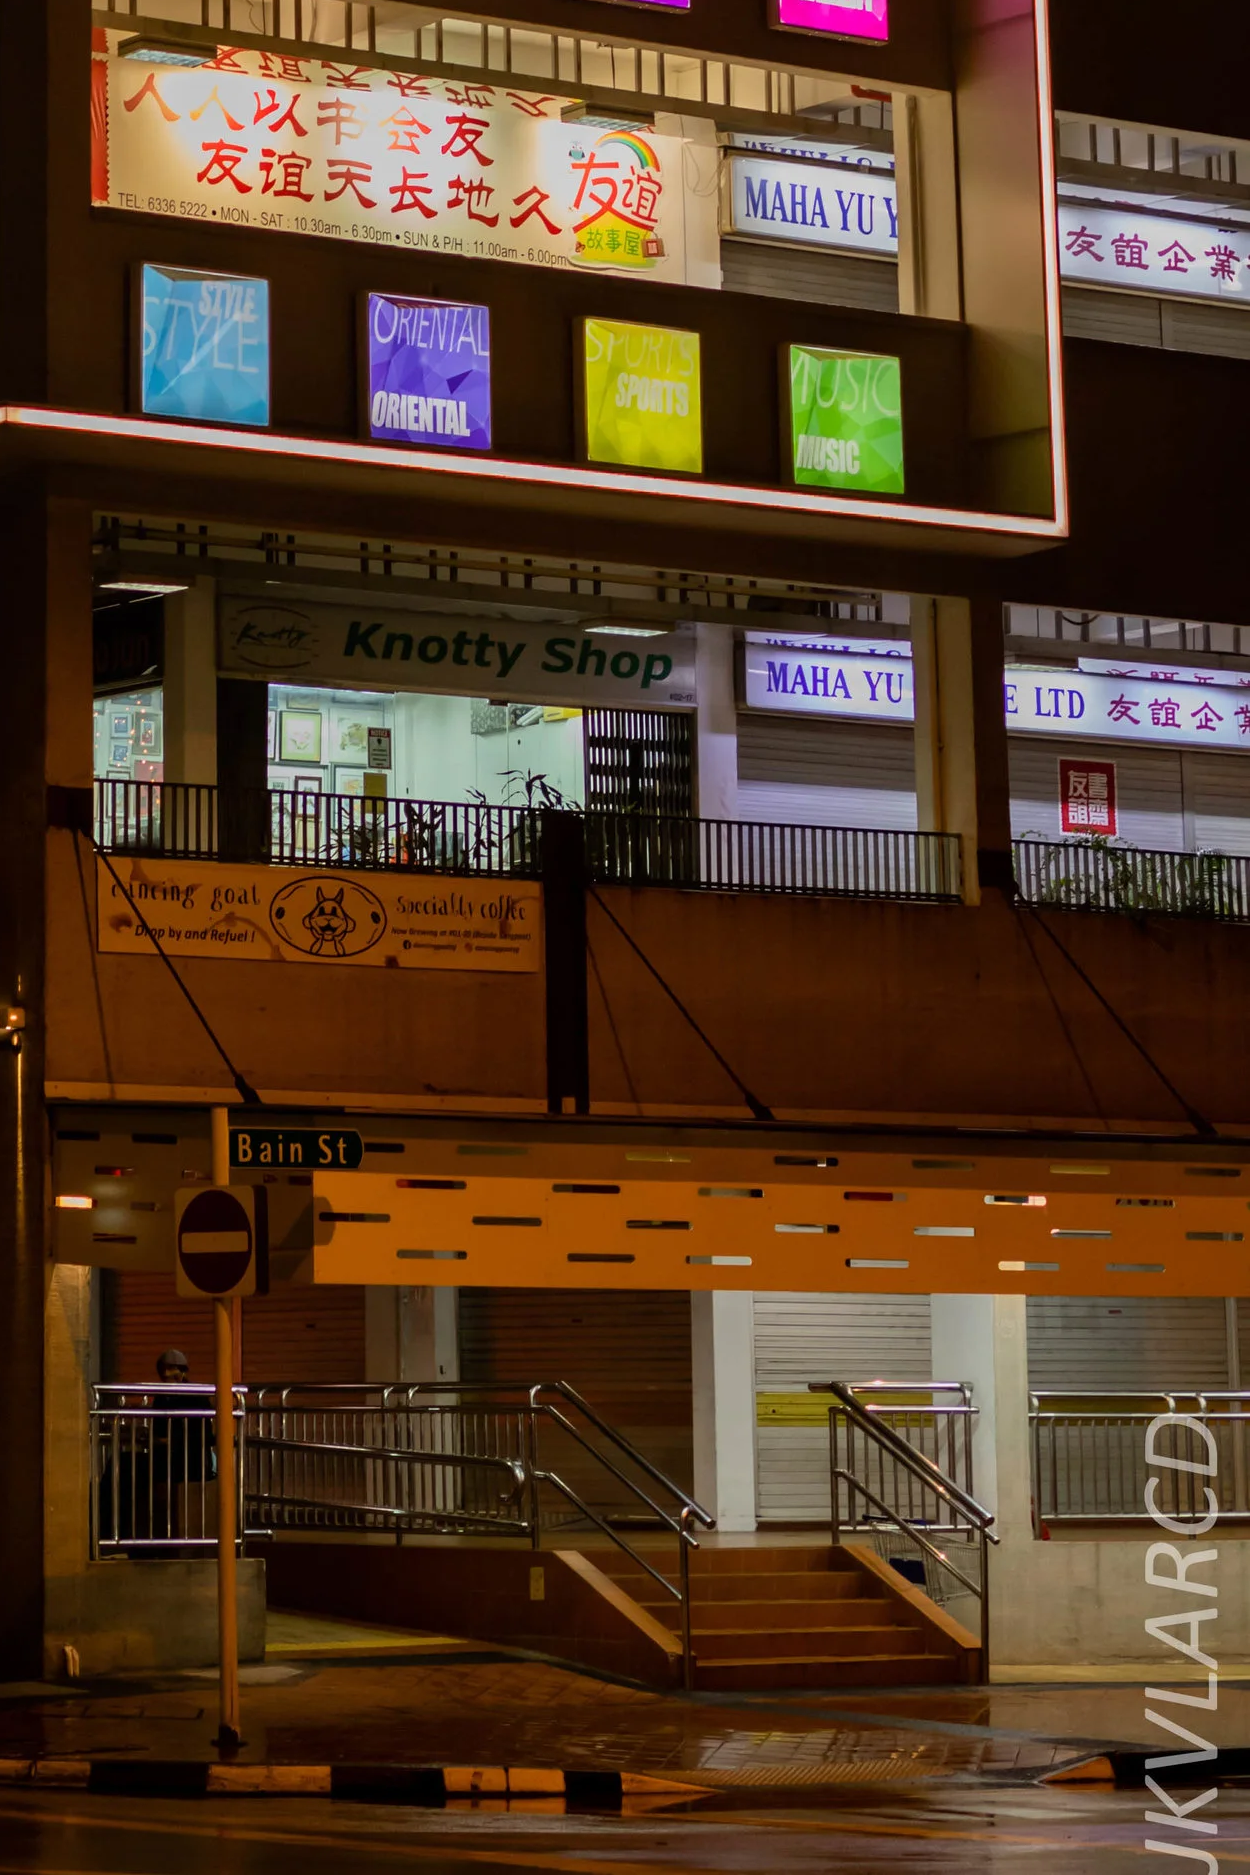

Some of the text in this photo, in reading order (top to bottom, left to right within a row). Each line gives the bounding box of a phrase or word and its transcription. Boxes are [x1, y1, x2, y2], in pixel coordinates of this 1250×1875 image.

[123, 71, 495, 168] 人人以书会友
[197, 138, 563, 236] 友谊天长地久
[571, 152, 662, 234] 友谊
[745, 176, 829, 229] MAHA
[835, 189, 875, 236] YU
[118, 192, 145, 210] TEL:
[148, 196, 176, 214] 6336
[180, 200, 208, 218] 5222
[220, 206, 250, 224] MON
[260, 211, 284, 228] SAT
[294, 216, 342, 236] 10.30am
[352, 224, 392, 244] 6.30pm
[403, 230, 428, 248] SUN
[443, 236, 464, 252] P/H
[473, 240, 518, 260] 11.00am
[528, 247, 567, 268] 6.00pm
[586, 227, 641, 256] 故事屋
[1065, 225, 1250, 282] 友誼企業
[200, 281, 259, 323] STYLE
[373, 298, 490, 357] ORIENTAL
[143, 296, 259, 374] STYLE
[586, 321, 697, 377] SPORTS
[372, 390, 471, 437] ORIENTAL
[615, 372, 689, 417] SPORTS
[796, 433, 860, 475] MUSIC
[344, 620, 673, 688] Knotty Shop
[766, 660, 904, 703] MAHA YU
[1035, 686, 1085, 719] LTD
[168, 926, 182, 942] by
[184, 926, 207, 940] and
[210, 928, 247, 945] Refuel
[238, 1133, 349, 1165] Bain St
